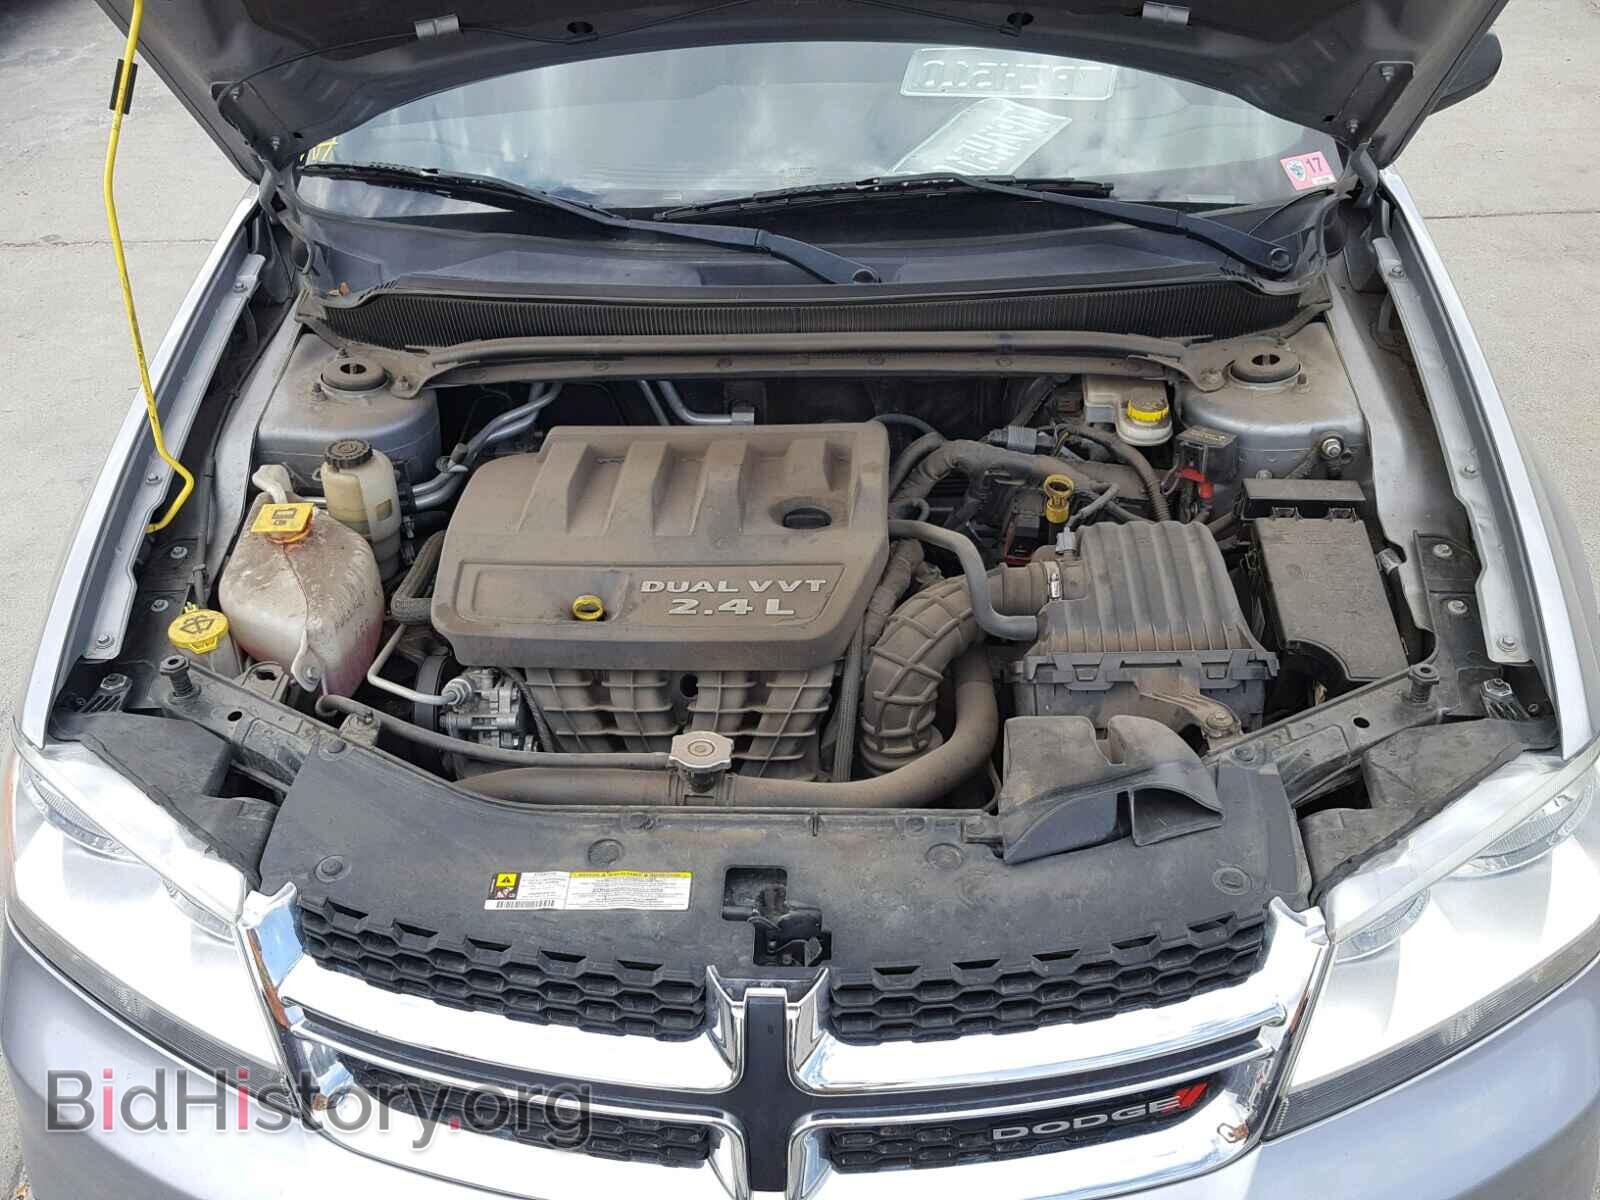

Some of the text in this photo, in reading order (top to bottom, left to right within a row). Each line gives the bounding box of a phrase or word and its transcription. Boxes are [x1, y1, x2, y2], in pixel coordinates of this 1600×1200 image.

[1305, 156, 1323, 174] 17
[639, 579, 827, 593] DUAL VVT
[667, 598, 795, 616] 2.4 L
[991, 1095, 1181, 1141] DODGE
